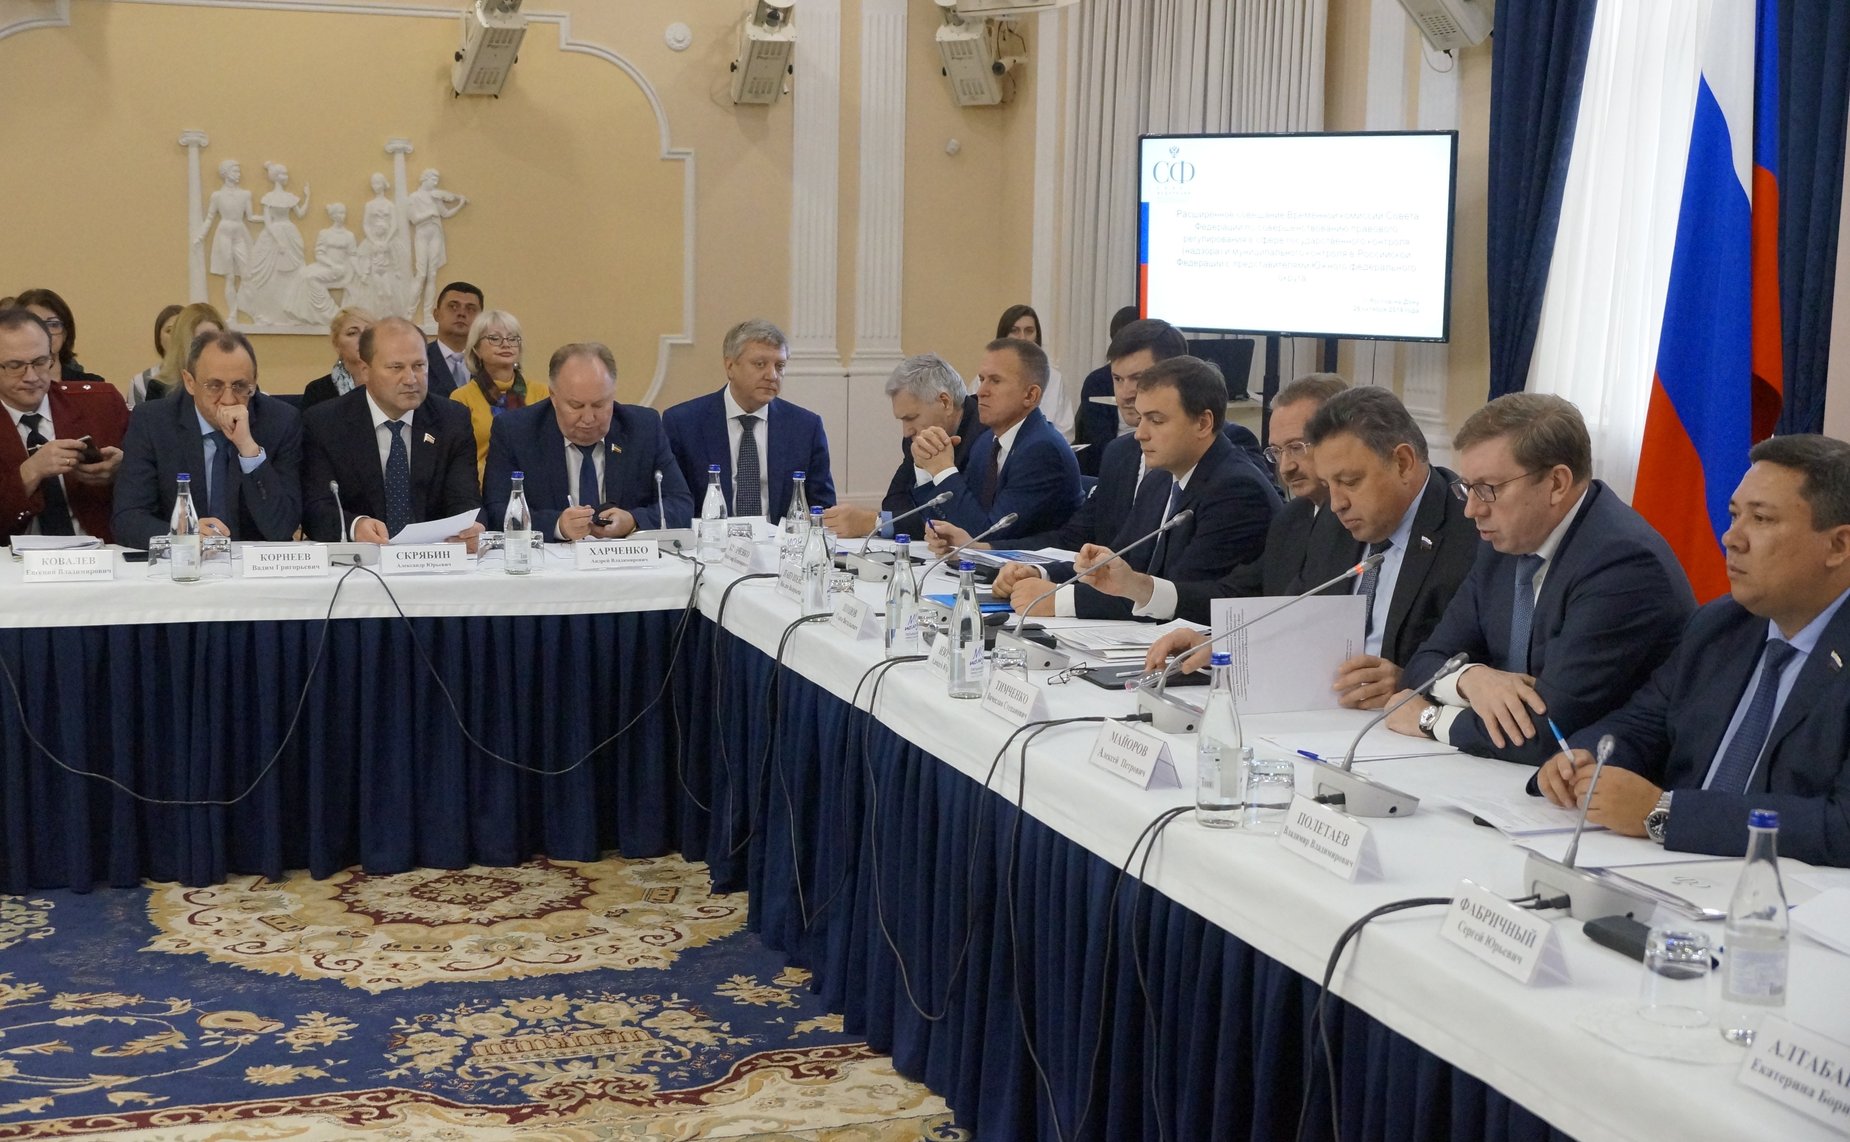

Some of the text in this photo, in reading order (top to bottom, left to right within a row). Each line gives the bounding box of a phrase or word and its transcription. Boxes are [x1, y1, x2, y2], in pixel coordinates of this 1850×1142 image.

[1152, 160, 1196, 184] СФ
[41, 556, 96, 566] КОВАЛЕВ
[260, 553, 311, 562] КОРНЕЕВ
[396, 550, 451, 560] СКРЯБИН
[589, 546, 649, 556] ХАРЧЕНКО
[58, 568, 112, 576] Владимирович
[276, 564, 320, 572] Григорьевич
[995, 680, 1029, 704] ТИМЧЕНКО
[1110, 730, 1149, 757] МАЙОРОВ
[1096, 746, 1146, 777] Алексей Петрович
[1296, 812, 1350, 847] ПОЛЕТАЕВ
[1283, 825, 1354, 868] Владимир Владимирович
[1459, 897, 1537, 949] ФАБРИЧНЫЙ
[1457, 920, 1523, 965] Сергей Юрьевич
[1751, 1057, 1816, 1099] Екатерина
